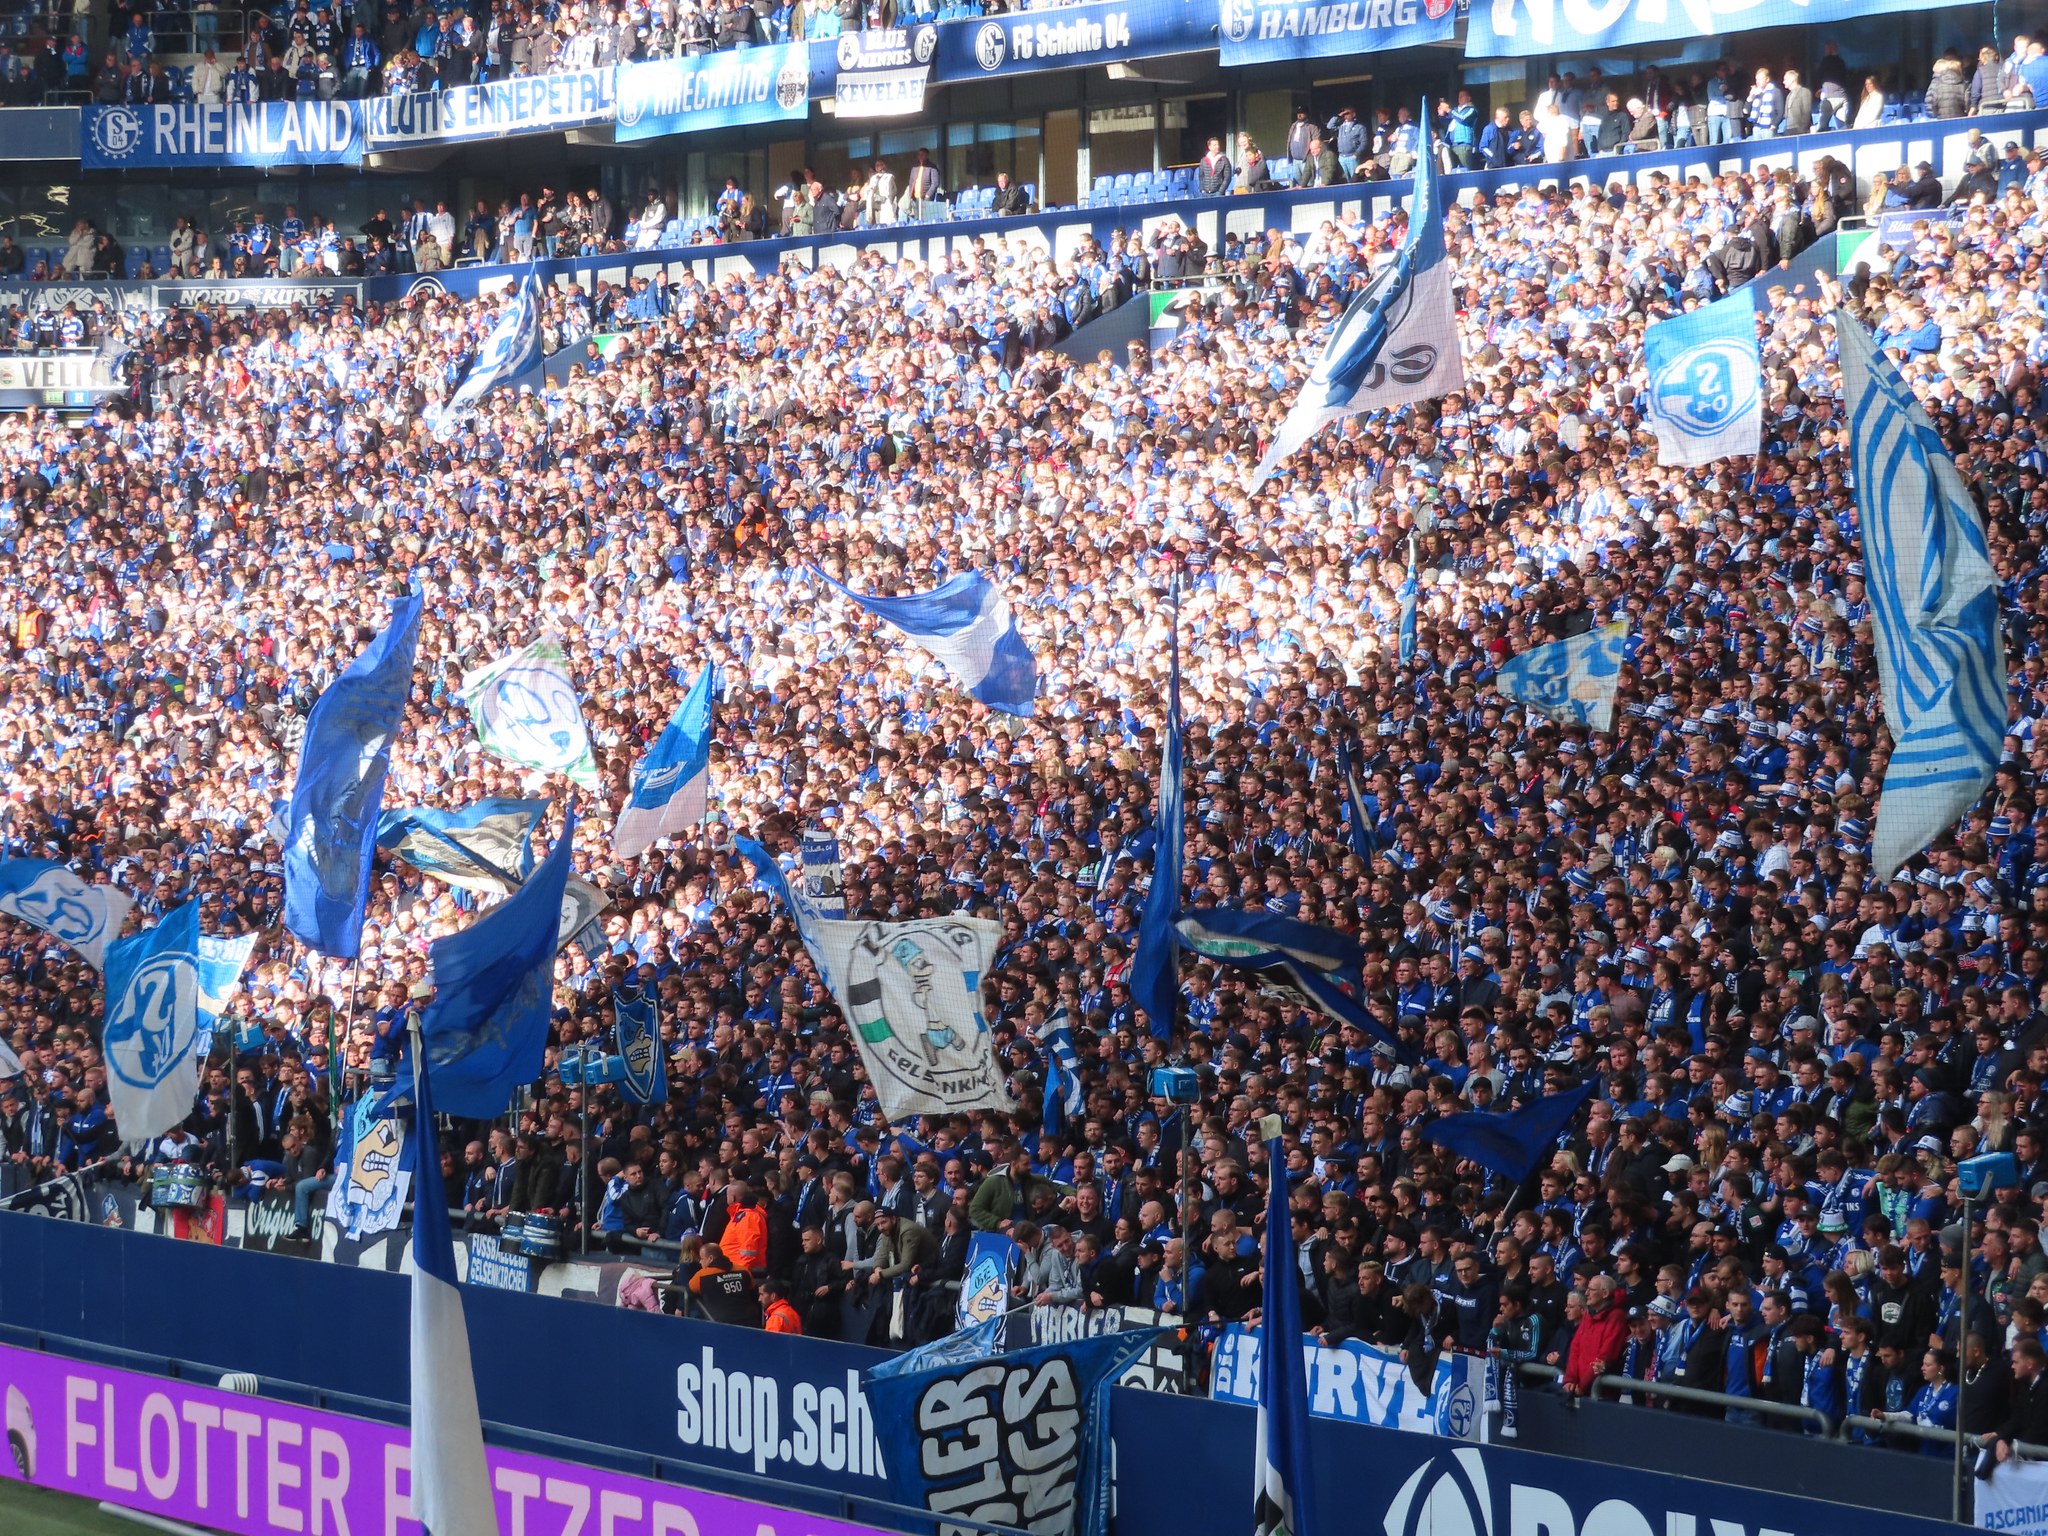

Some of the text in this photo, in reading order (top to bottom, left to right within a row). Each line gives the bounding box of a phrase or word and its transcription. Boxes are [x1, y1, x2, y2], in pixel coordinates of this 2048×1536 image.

[866, 29, 907, 50] BLUE
[1012, 12, 1131, 60] FC Schalke 04
[1258, 1, 1417, 40] HAMBURG
[465, 69, 610, 126] ENNEPETAL
[154, 100, 352, 155] RHEINLAND
[180, 288, 241, 305] NORD
[22, 361, 98, 388] VELT
[248, 1197, 297, 1250] Origin
[470, 1257, 528, 1292] GELSENKIRCHEN
[723, 1280, 743, 1294] 950
[1233, 1334, 1438, 1435] KRVE
[66, 1374, 352, 1536] FLOTTER
